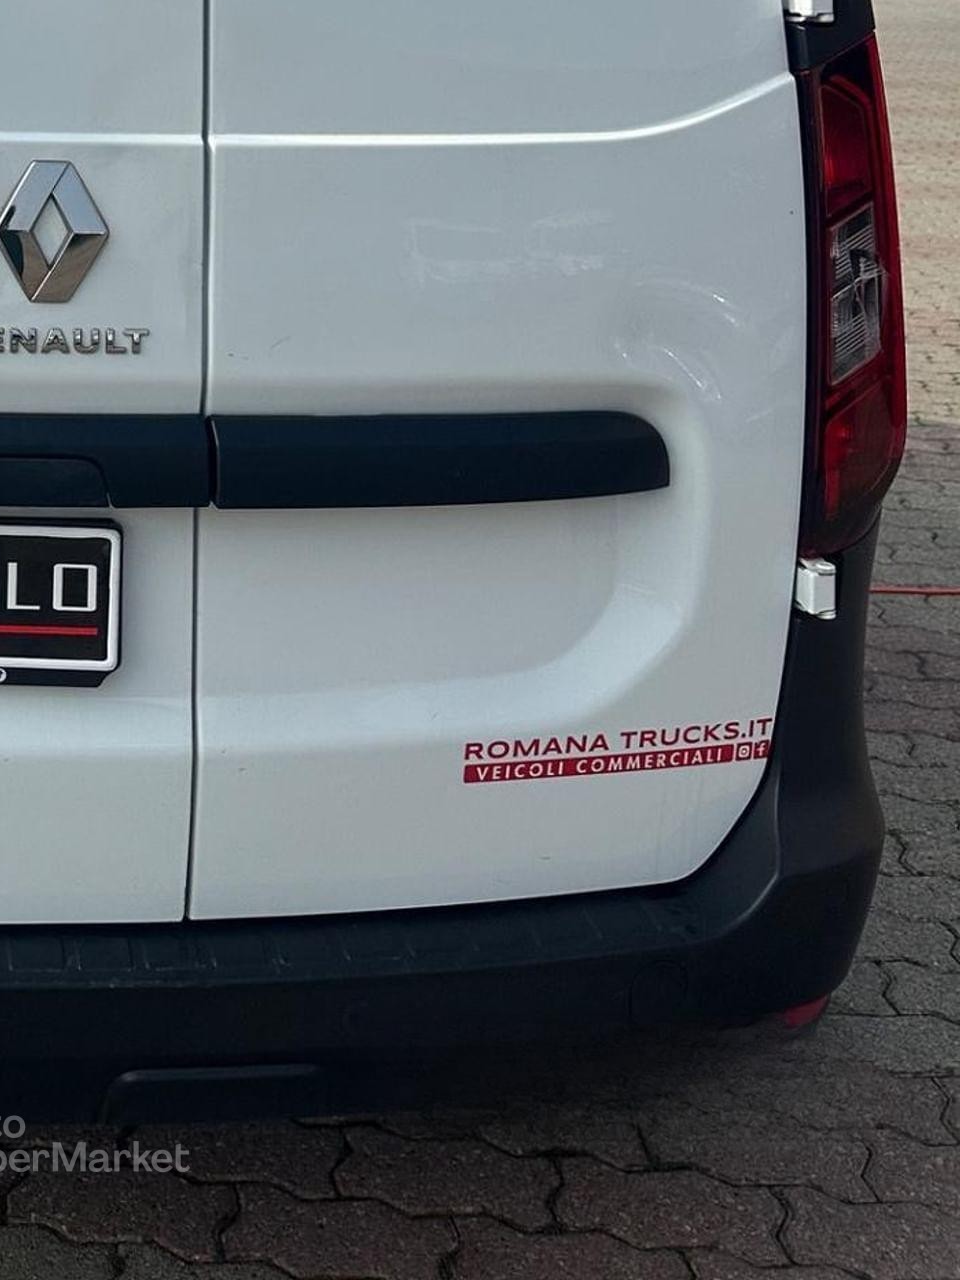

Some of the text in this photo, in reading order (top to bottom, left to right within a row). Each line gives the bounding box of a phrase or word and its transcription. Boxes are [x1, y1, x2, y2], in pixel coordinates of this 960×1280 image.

[464, 718, 773, 761] ROMANA TRUCKS.IT
[477, 747, 723, 781] VEICOLI COMMERCIALI
